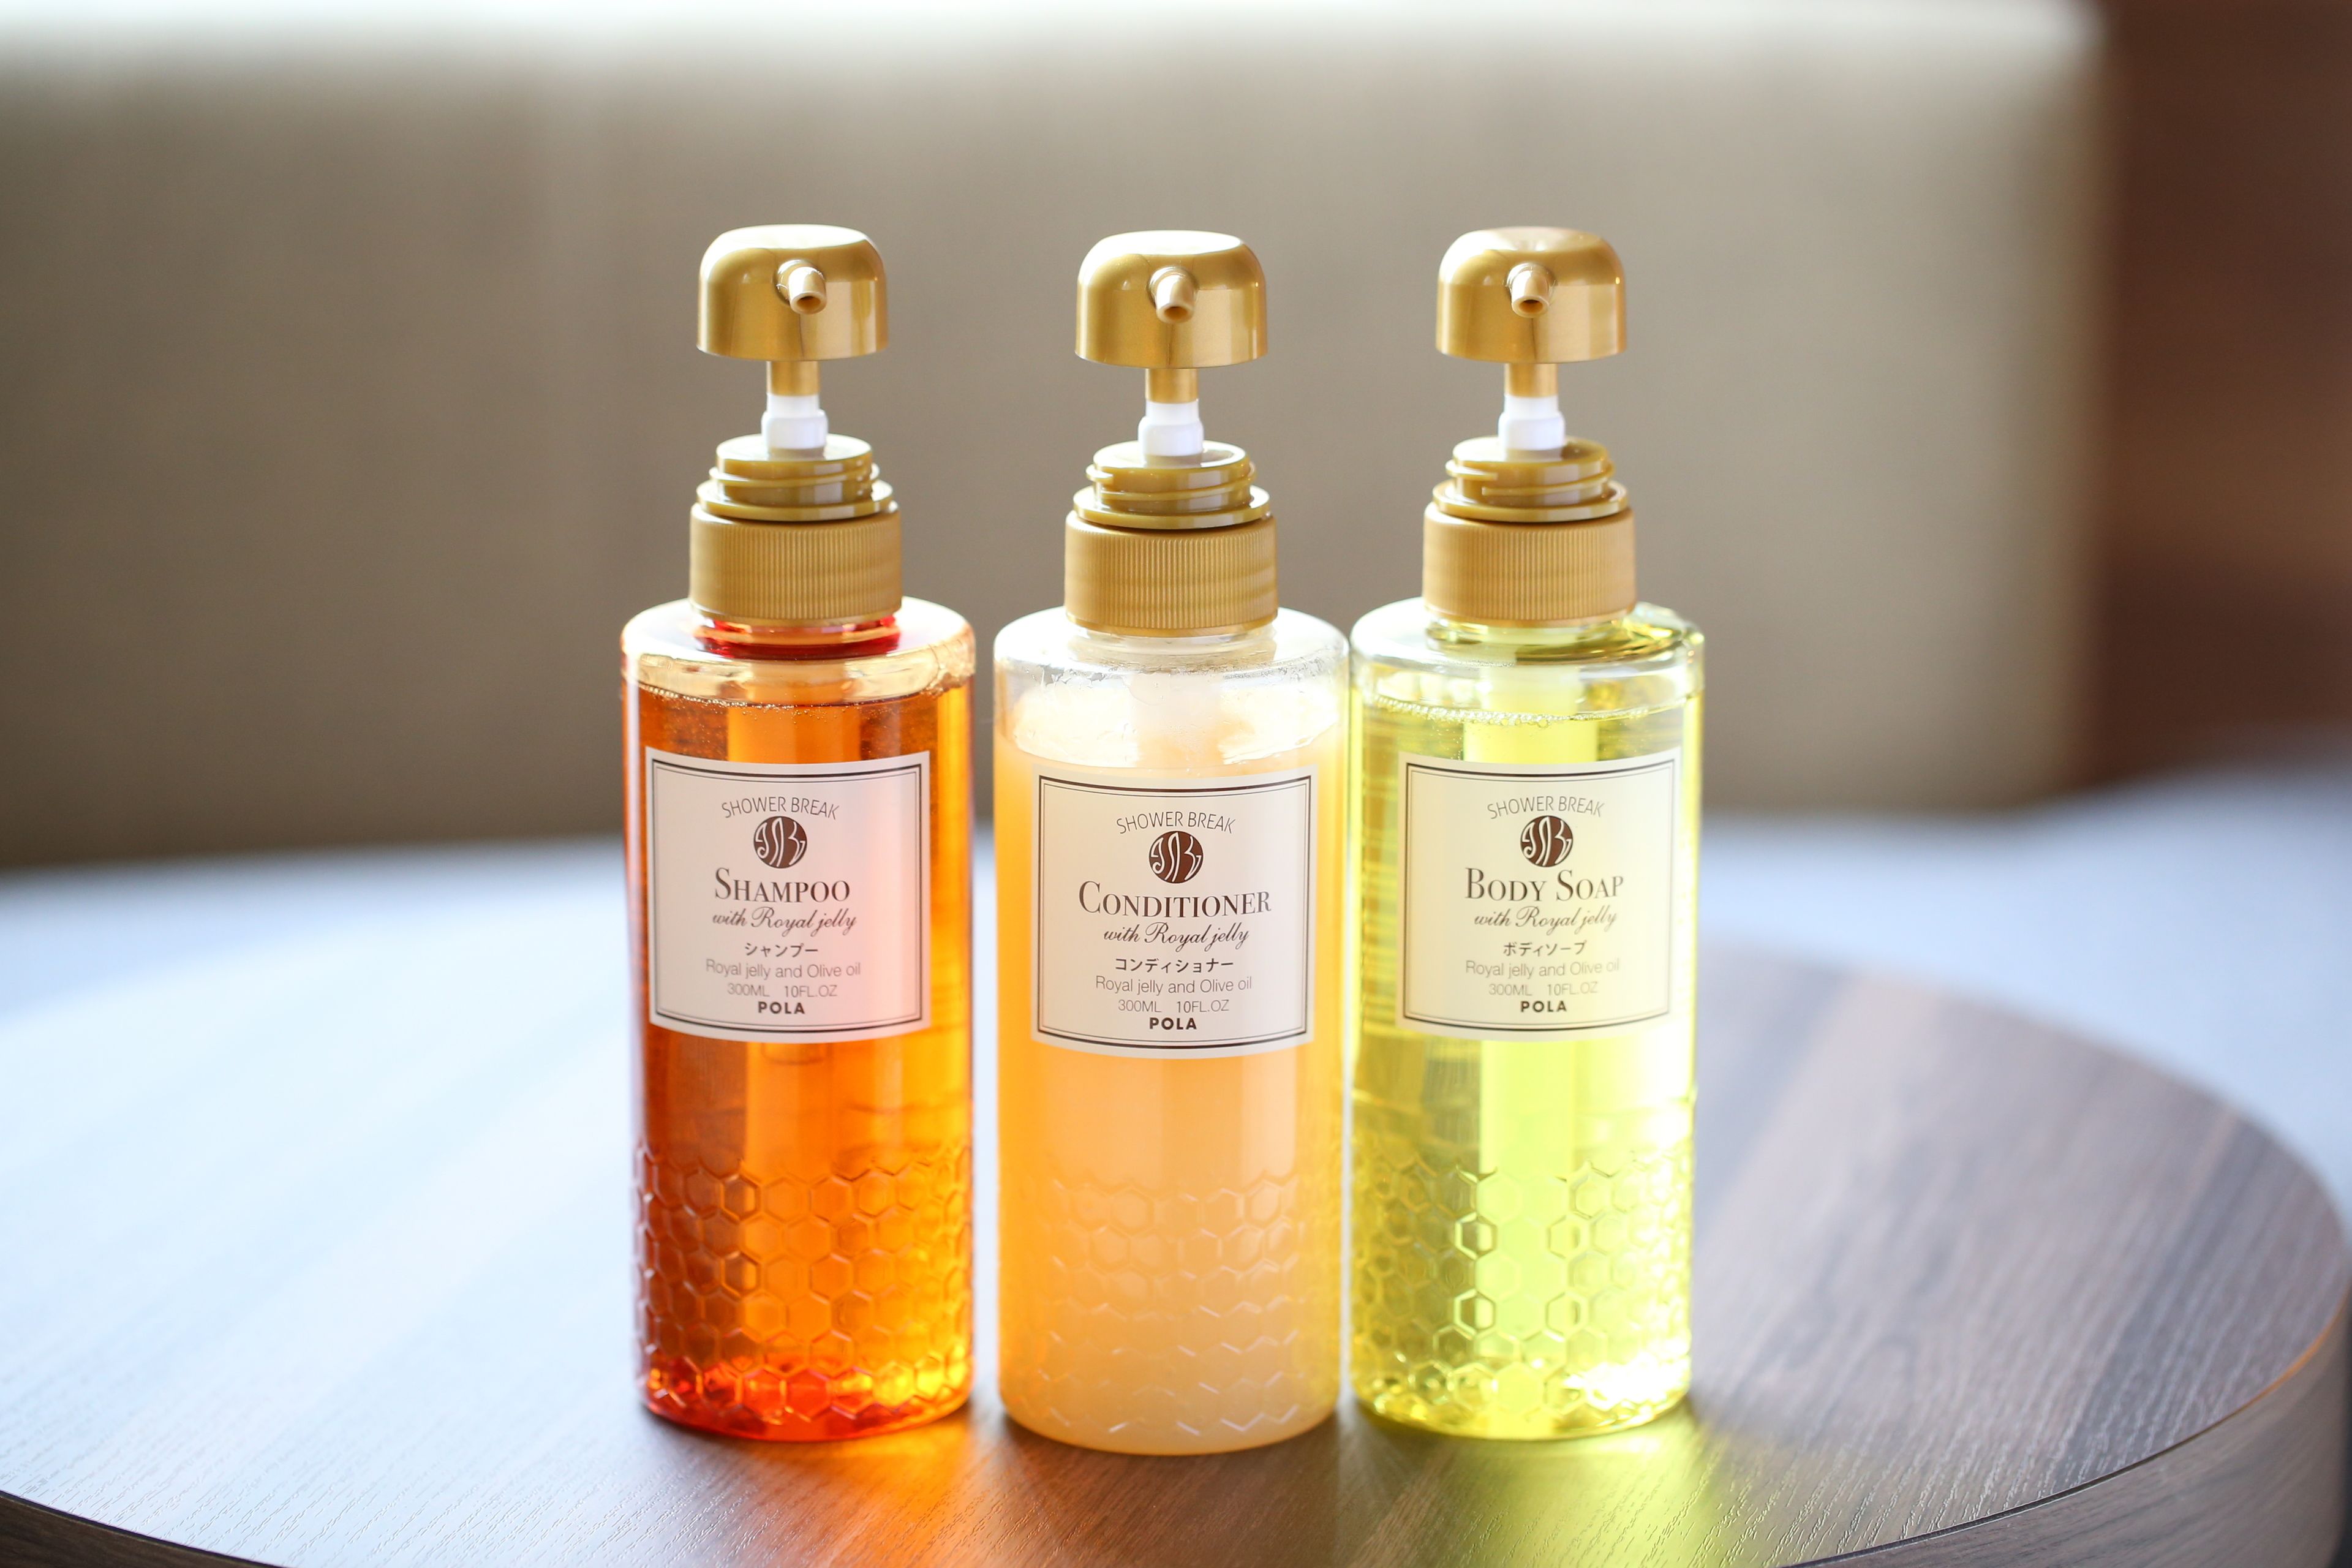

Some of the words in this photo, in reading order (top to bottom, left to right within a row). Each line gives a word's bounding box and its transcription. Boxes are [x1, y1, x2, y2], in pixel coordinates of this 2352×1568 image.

[722, 796, 786, 818] SHOWER
[791, 797, 840, 820] BREAK
[1487, 796, 1554, 820] SHOWER
[1558, 796, 1605, 817] BREAK
[1117, 811, 1183, 834] SHOWER
[1188, 812, 1236, 834] BREAK
[715, 867, 851, 903] SHAMPOO
[1465, 867, 1547, 902] BODY
[1555, 869, 1624, 902] SOAP
[1079, 881, 1272, 918] CONDITIONER
[712, 908, 746, 927] with
[750, 906, 815, 937] Royal
[811, 908, 857, 937] jelly
[1474, 908, 1512, 927] with
[1515, 905, 1578, 935] Royal
[1574, 905, 1617, 935] jelly
[1103, 924, 1140, 943] with
[1144, 922, 1211, 952] Royal
[1204, 922, 1250, 952] jelly
[744, 941, 818, 958] シャンプー
[1502, 940, 1587, 957] ボディソープ
[706, 959, 742, 977] Royal
[745, 963, 771, 981] jelly
[775, 965, 802, 978] and
[807, 963, 842, 978] Olive
[846, 962, 861, 976] oil
[1115, 957, 1234, 973] コンディショナー
[1466, 960, 1504, 977] Royal
[1507, 963, 1534, 979] jelly
[1539, 963, 1565, 977] and
[1569, 962, 1602, 975] Olive
[1606, 958, 1619, 973] oil
[727, 983, 769, 997] 300ML
[783, 985, 838, 998] 10FL.OZ
[1095, 976, 1133, 993] Royal
[1136, 978, 1164, 997] jelly
[1167, 980, 1196, 993] and
[1200, 979, 1234, 993] Olive
[1237, 976, 1252, 990] oil
[1488, 983, 1532, 996] 300ML
[1547, 981, 1598, 996] 10FL.OZ
[758, 1001, 805, 1014] POLA
[1118, 1000, 1162, 1013] 300ML
[1176, 1000, 1230, 1013] 10FL.OZ
[1520, 1001, 1567, 1013] POLA
[1149, 1017, 1197, 1030] POLA
